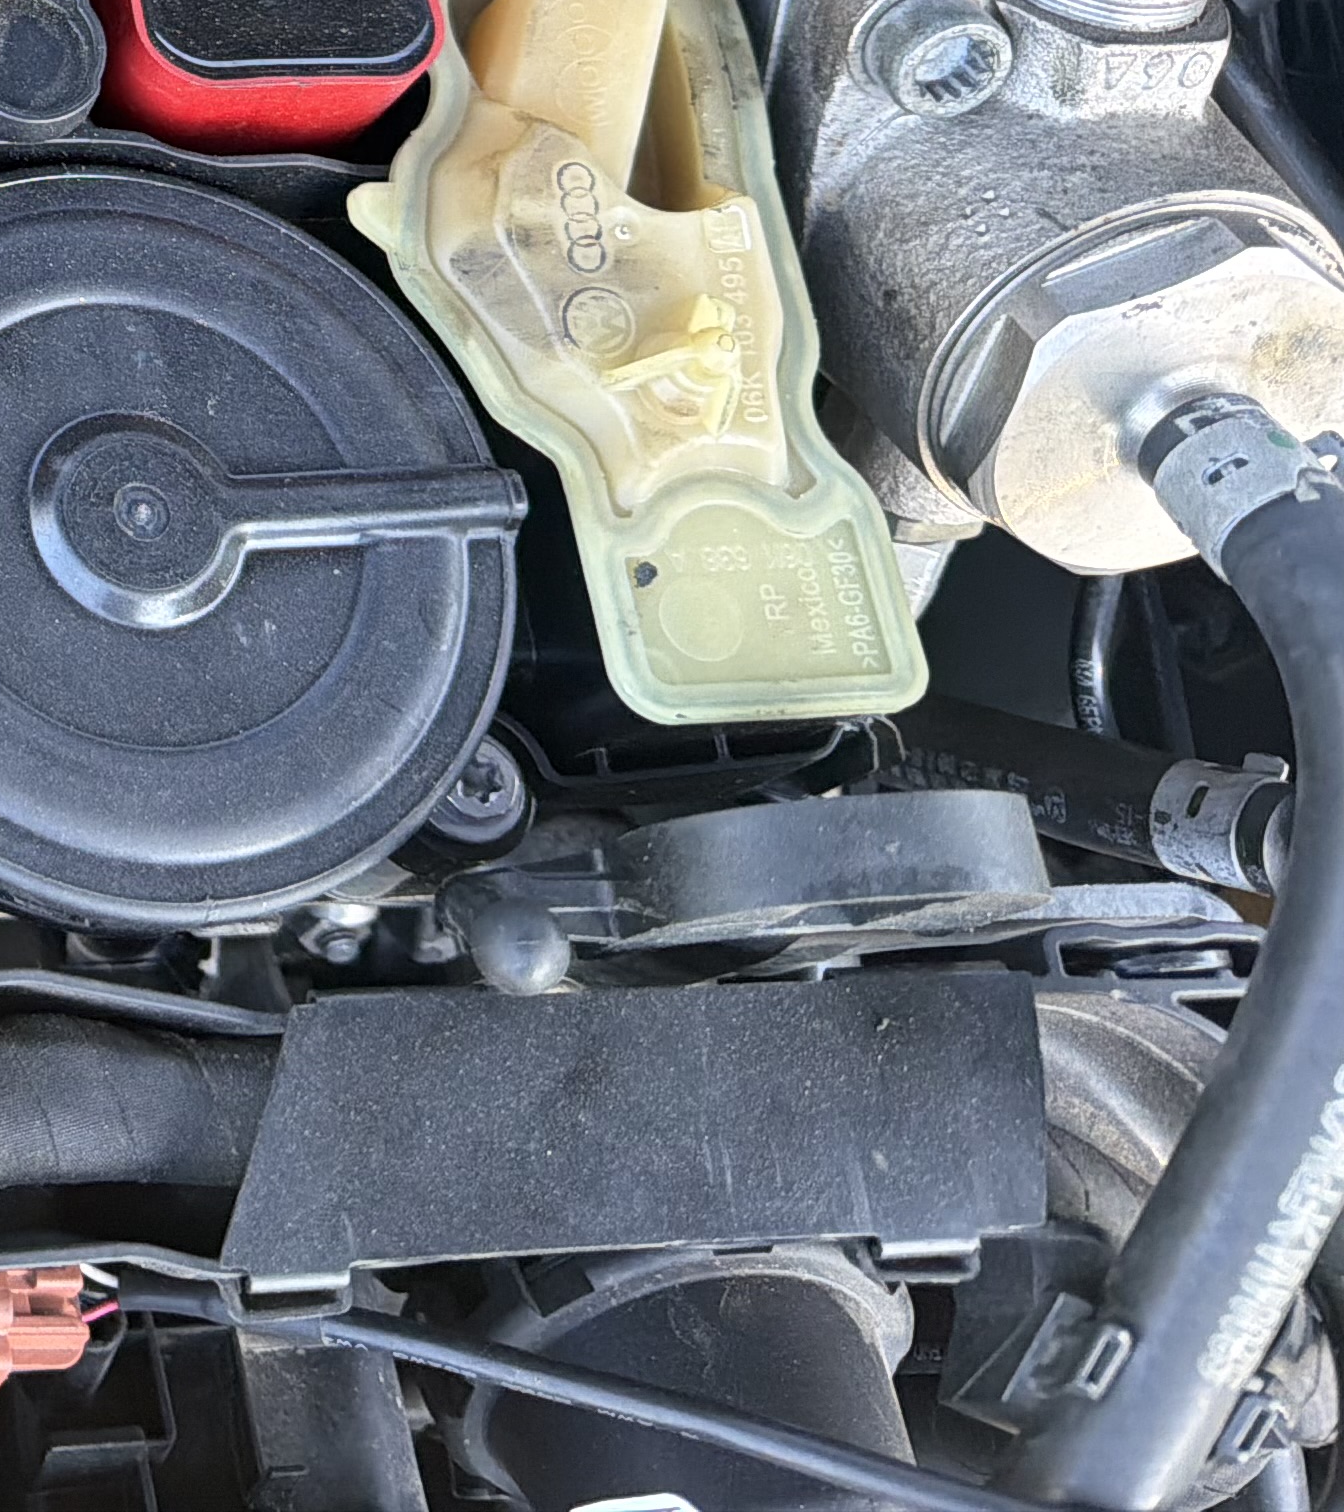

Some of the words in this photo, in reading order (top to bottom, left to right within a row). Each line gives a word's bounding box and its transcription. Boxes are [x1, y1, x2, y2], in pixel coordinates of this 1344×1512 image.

[718, 257, 748, 304] 495
[742, 372, 768, 424] 06K
[759, 583, 789, 620] RP
[798, 563, 838, 655] Mexico
